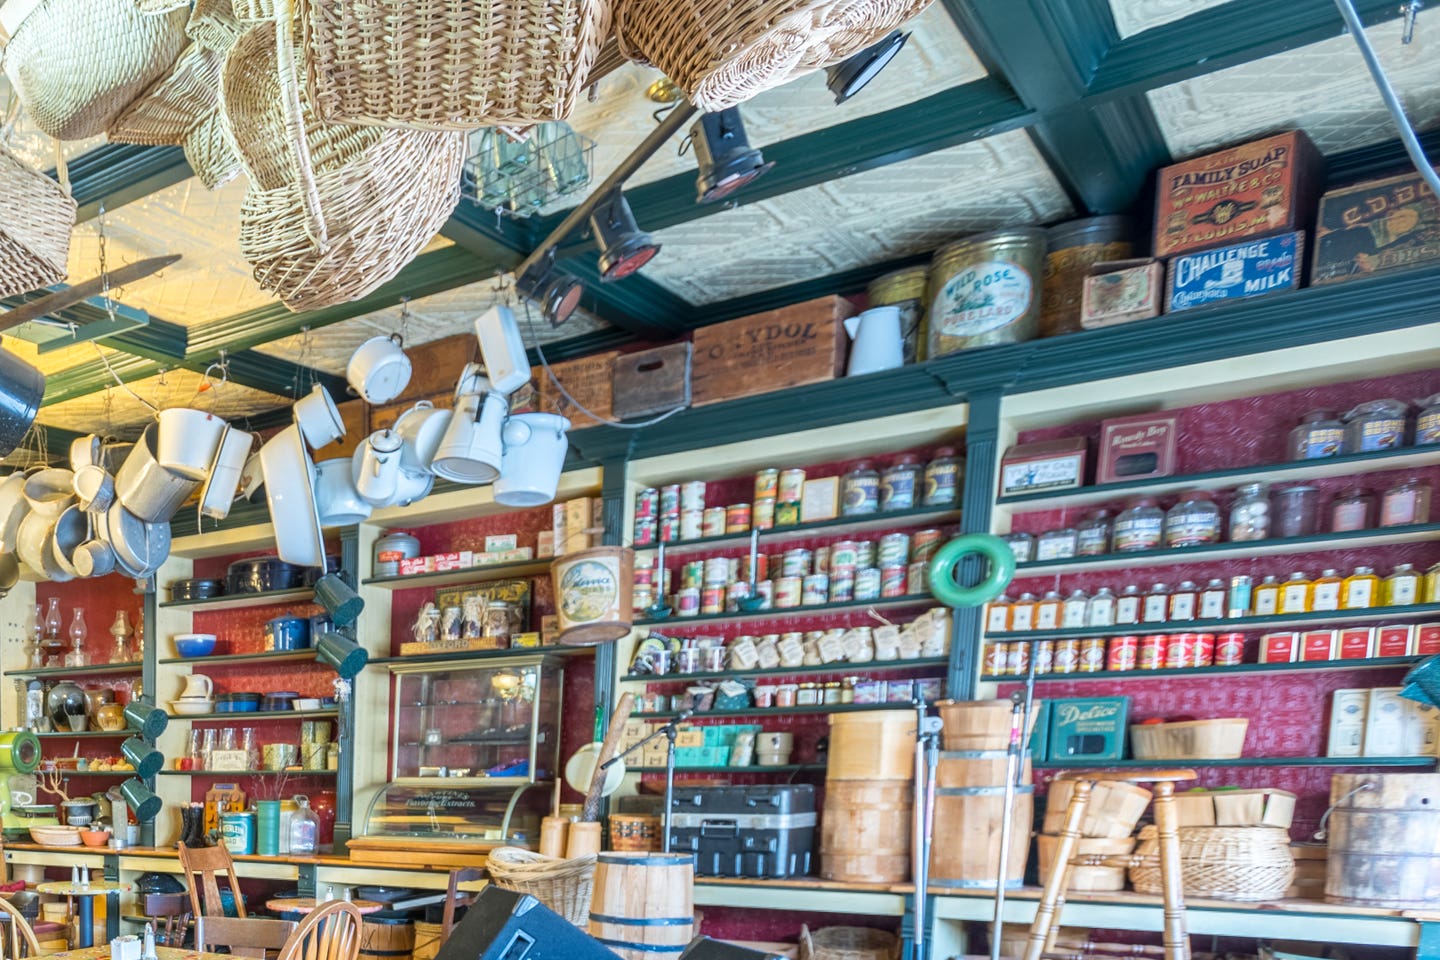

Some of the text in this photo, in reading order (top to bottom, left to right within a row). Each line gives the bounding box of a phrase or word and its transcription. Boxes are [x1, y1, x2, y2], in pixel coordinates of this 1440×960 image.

[1171, 146, 1287, 191] FAMILY SOAP
[946, 268, 1015, 298] WILD ROSE
[1176, 242, 1270, 288] CHALLENGE
[1244, 267, 1292, 293] MILK
